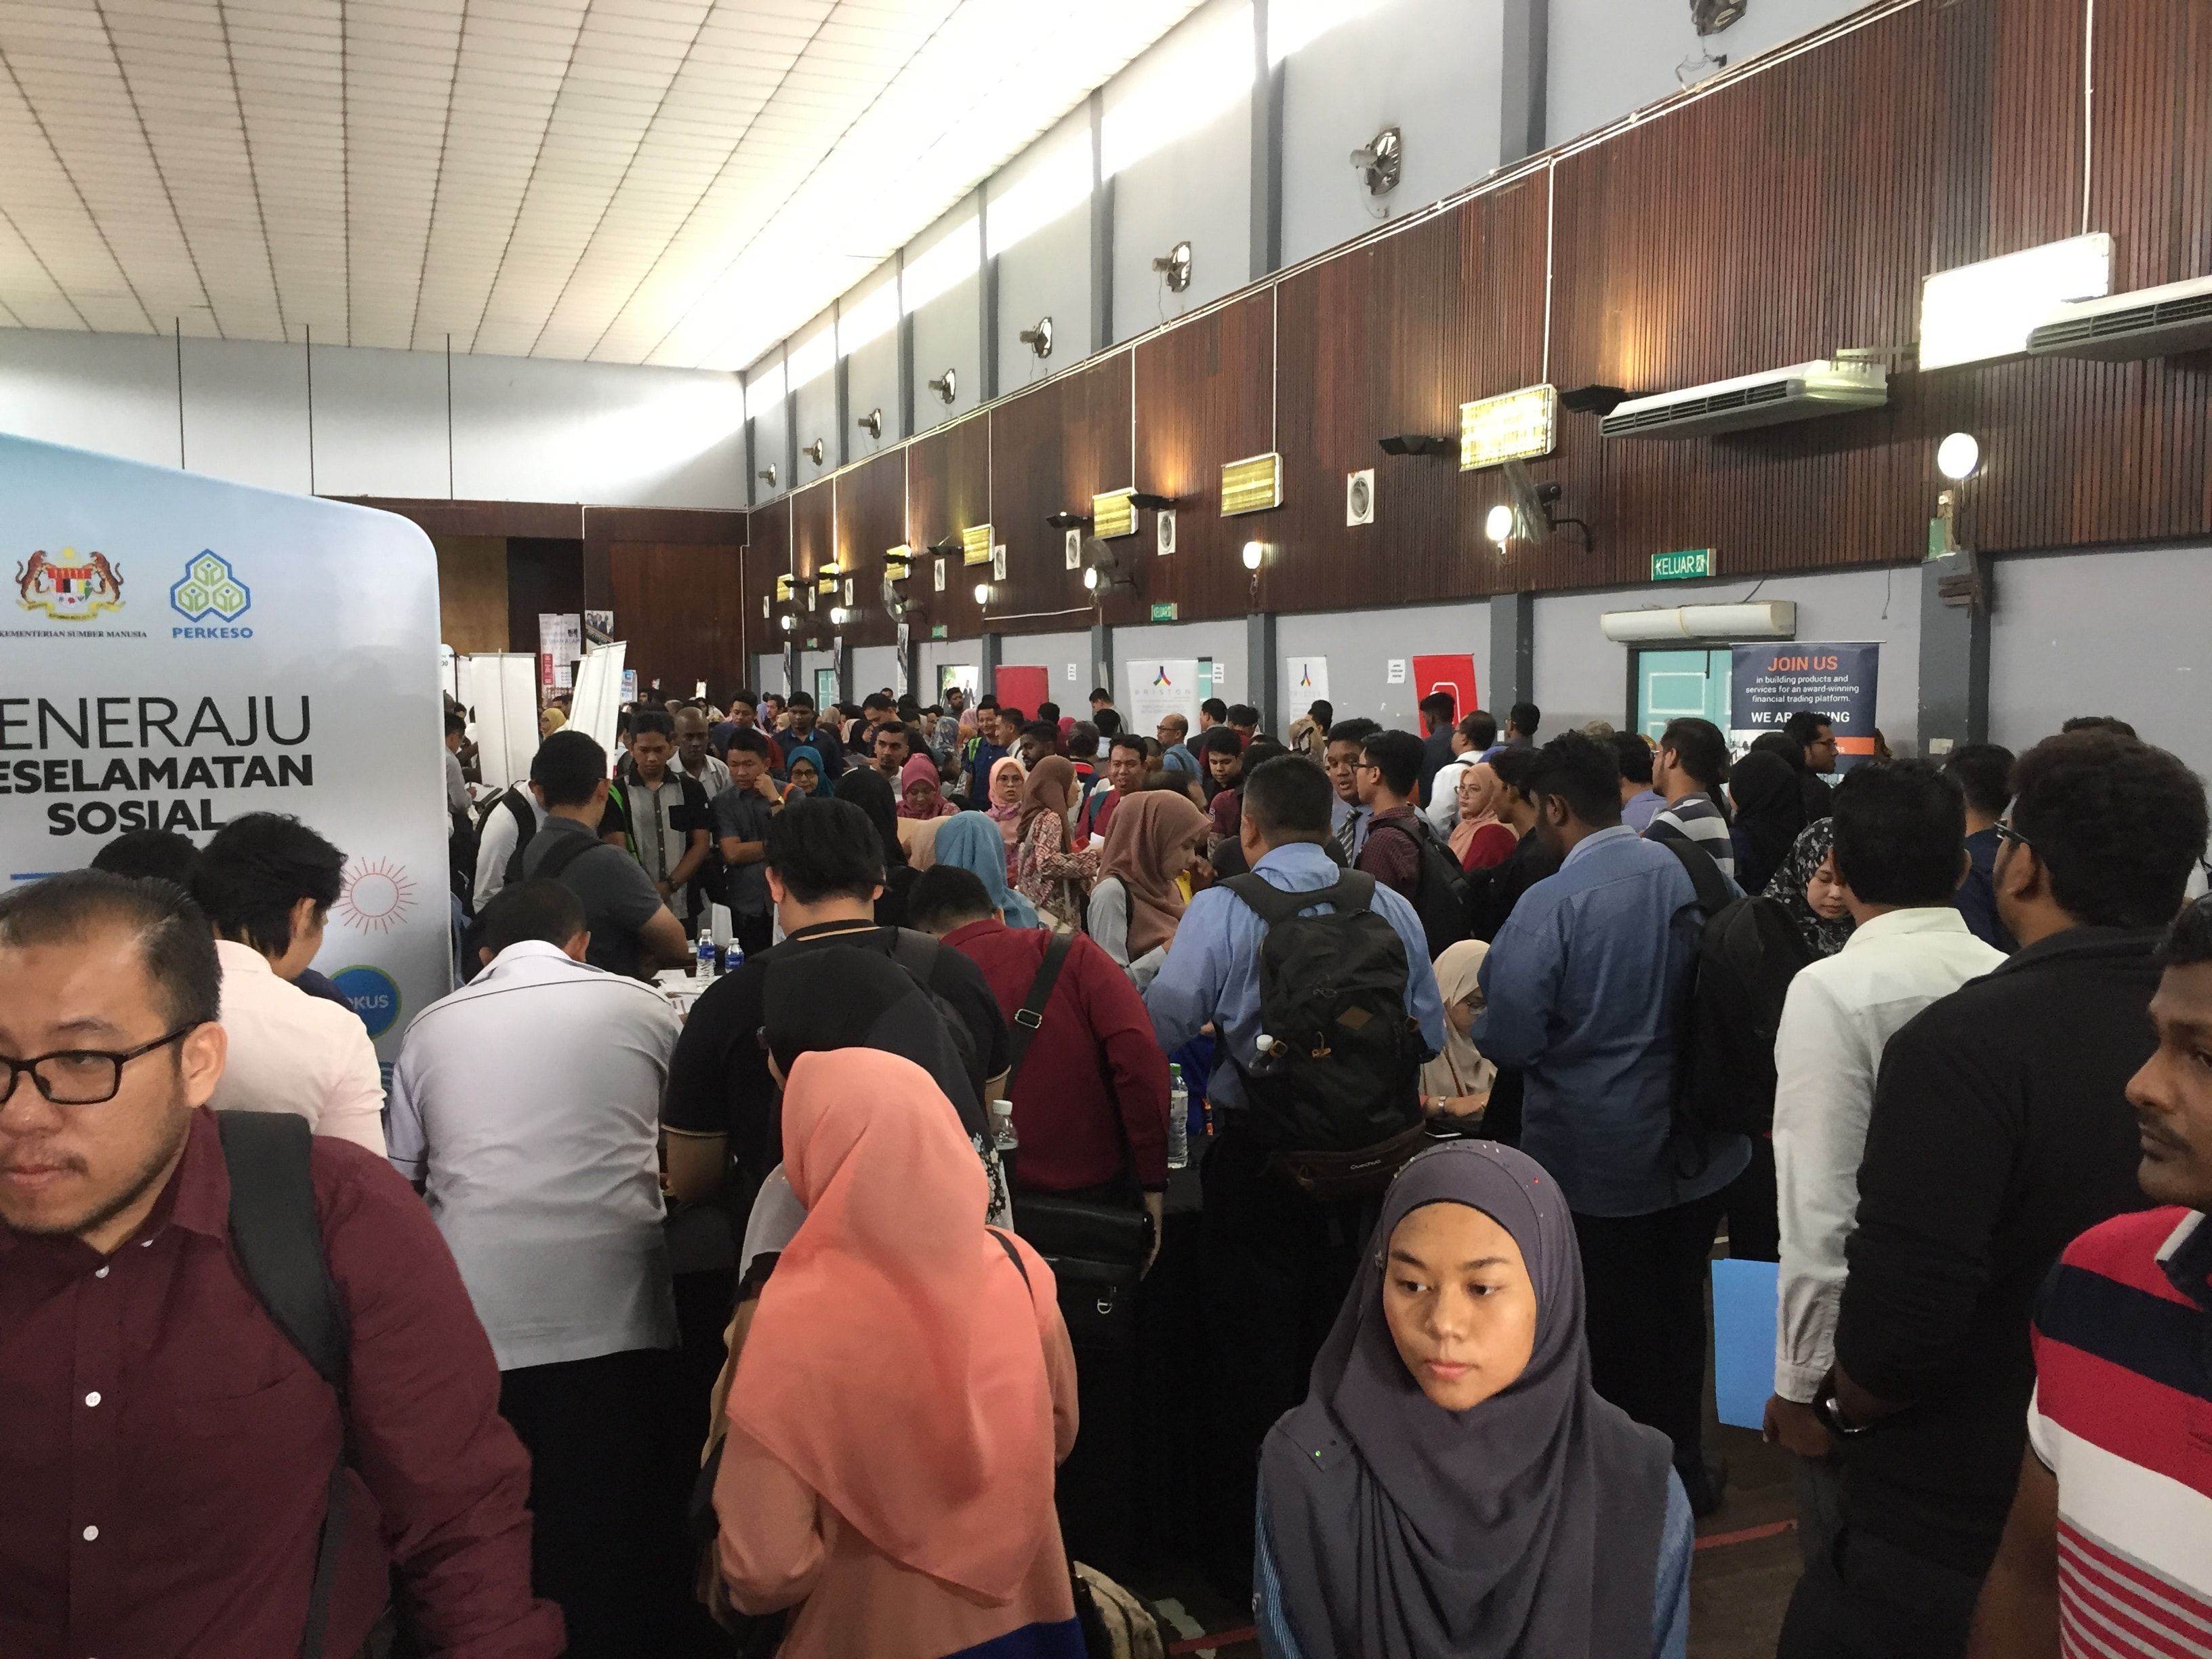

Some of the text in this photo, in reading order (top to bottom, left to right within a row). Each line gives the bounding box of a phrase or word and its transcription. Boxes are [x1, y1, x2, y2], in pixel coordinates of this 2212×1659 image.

[1656, 556, 1695, 575] KELUAR
[172, 627, 253, 638] PERKESO
[1767, 655, 1839, 672] JOIN US
[1765, 676, 1796, 684] building
[1797, 675, 1831, 684] products
[1833, 674, 1849, 682] and
[1803, 684, 1860, 694] award-winning
[1752, 695, 1851, 703] financial trading platform.
[1750, 712, 1771, 723] WE
[47, 798, 227, 836] SOSIAL
